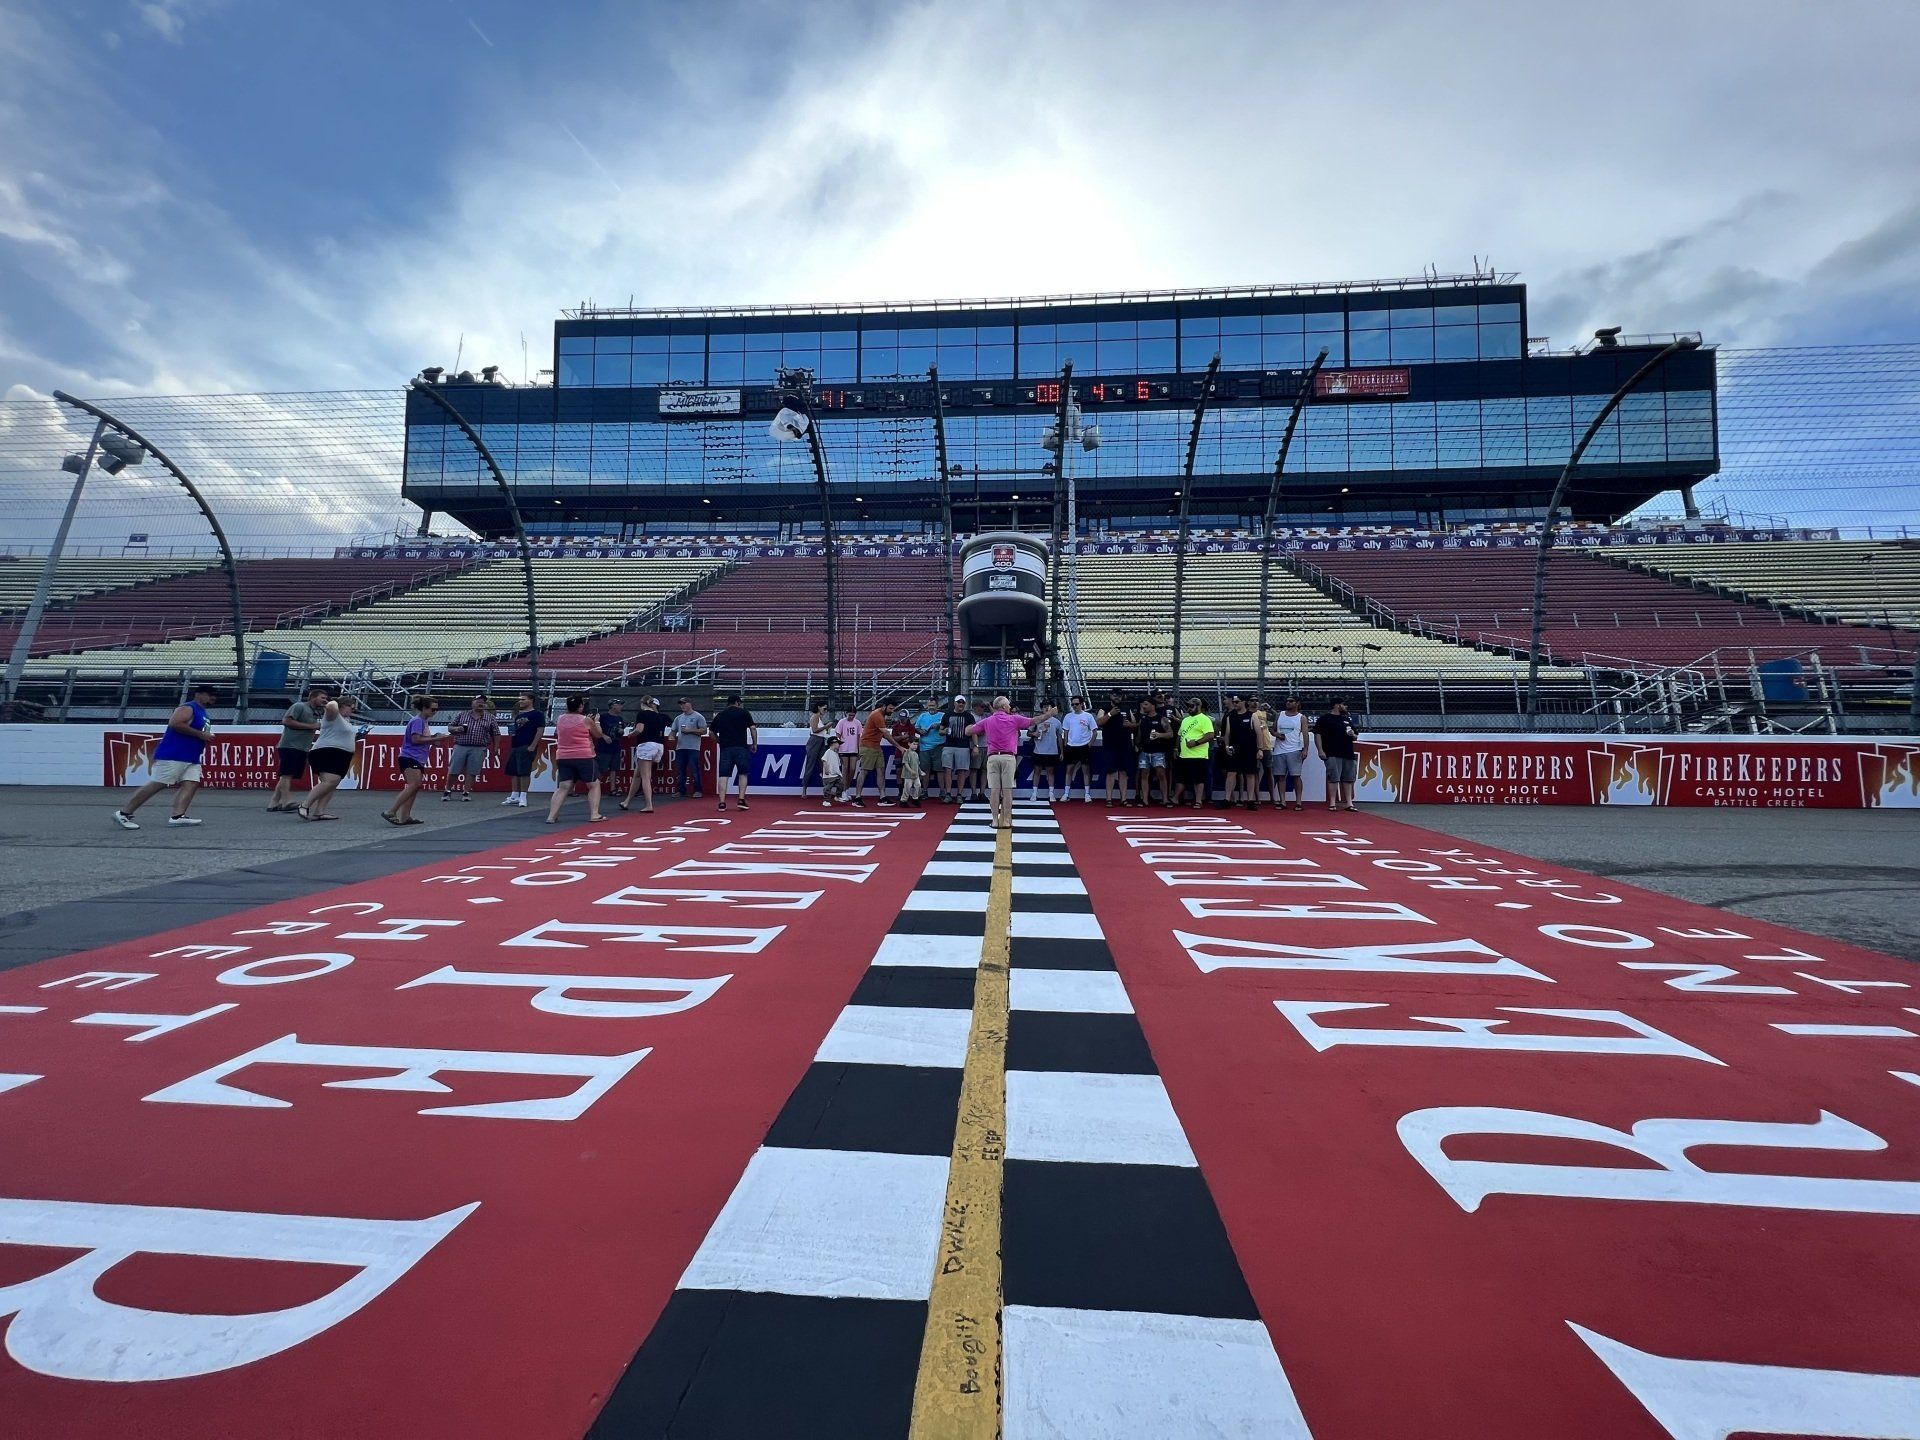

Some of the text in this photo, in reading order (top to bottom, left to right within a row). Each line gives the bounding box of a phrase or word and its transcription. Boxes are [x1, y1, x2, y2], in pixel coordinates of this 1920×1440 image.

[856, 395, 862, 403] 2
[899, 394, 905, 402] 3
[1092, 383, 1104, 401] 4
[1137, 381, 1149, 399] 6
[1161, 386, 1168, 394] 9
[1106, 545, 1124, 555] ally
[1156, 544, 1174, 555] ally
[1206, 543, 1224, 553] ally
[1311, 541, 1329, 551] ally
[1363, 541, 1382, 551] ally
[1416, 540, 1434, 550] ally
[1469, 538, 1489, 548] ally
[1581, 536, 1601, 546] ally
[1637, 534, 1657, 545] ally
[1694, 533, 1715, 544] ally
[1752, 532, 1773, 542] ally
[1811, 531, 1832, 541] ally
[361, 550, 378, 559] ally
[405, 550, 421, 559] ally
[449, 550, 466, 558] ally
[494, 549, 510, 559] ally
[538, 549, 555, 559] ally
[585, 549, 602, 559] ally
[631, 549, 647, 560] ally
[676, 548, 693, 558] ally
[722, 548, 739, 558] ally
[768, 547, 784, 557] ally
[864, 547, 881, 557] ally
[911, 546, 928, 557] ally
[1421, 751, 1574, 780] FIREKEEPERS
[1680, 753, 1842, 782] FIREKEEPERS
[246, 772, 277, 780] HOTE
[1436, 784, 1558, 795] CASINO HOTEL
[1695, 787, 1825, 798] CASINO HOTEL
[1454, 795, 1540, 804] BATTLE CREEK
[1714, 798, 1805, 807] BATTLE CREEK
[1300, 829, 1504, 891] HOTEL
[1418, 848, 1623, 904] CREEK
